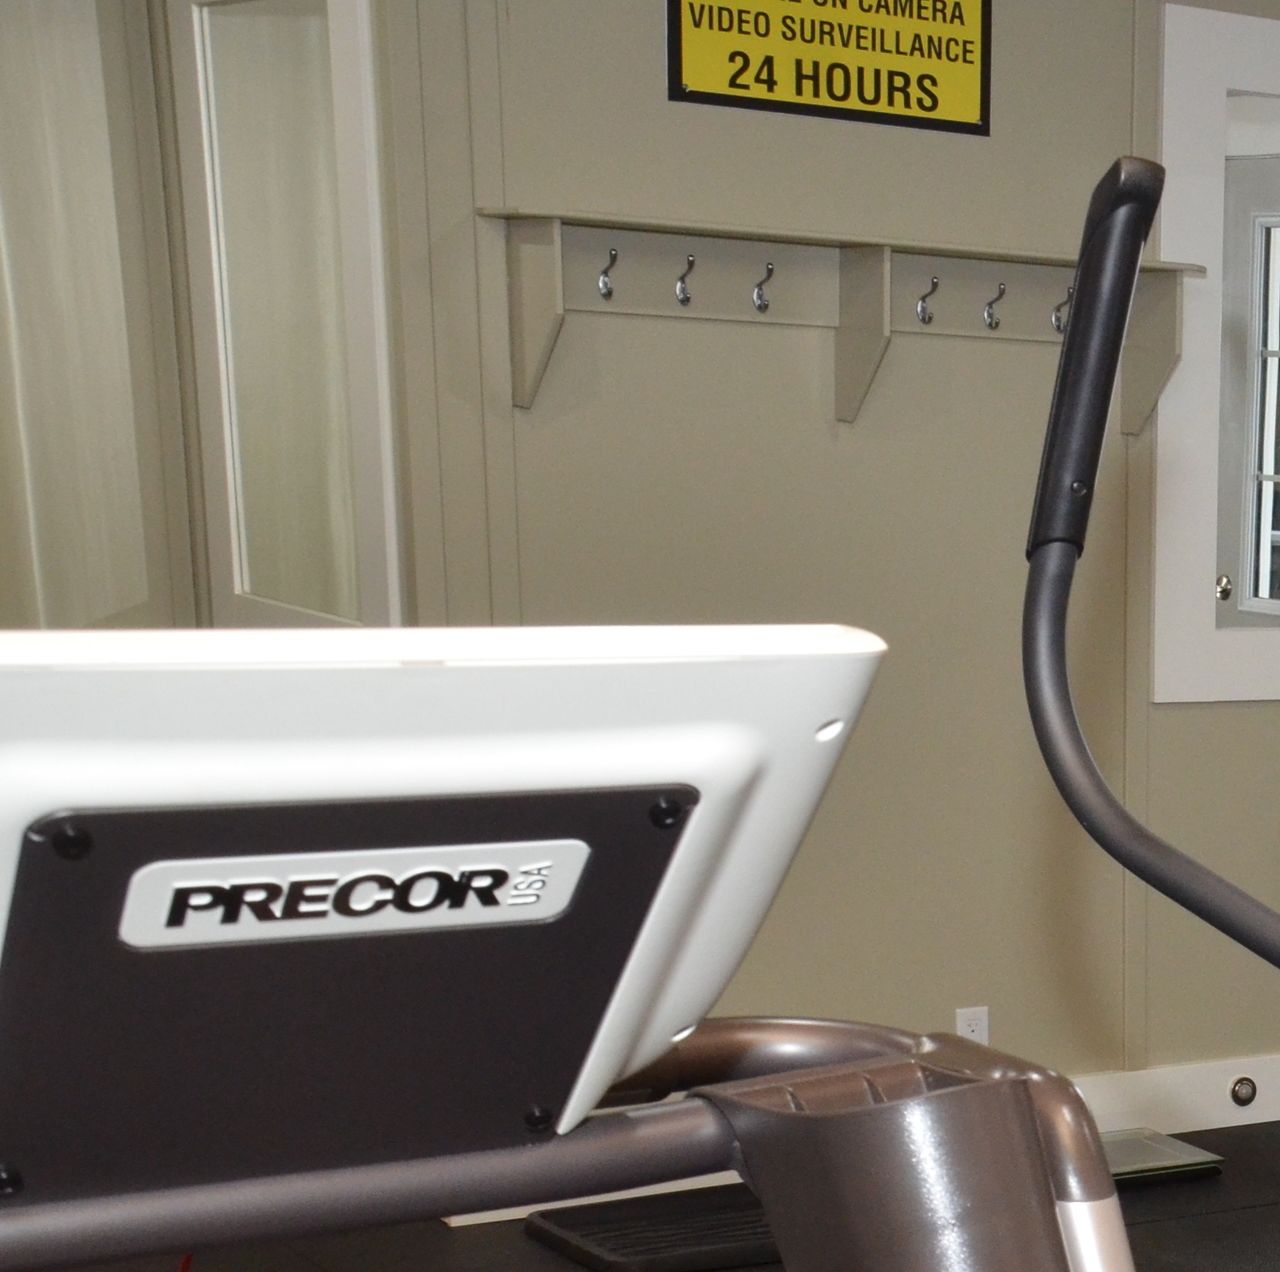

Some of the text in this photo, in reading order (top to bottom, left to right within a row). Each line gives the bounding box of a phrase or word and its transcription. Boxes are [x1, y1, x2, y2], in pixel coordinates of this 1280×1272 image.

[688, 2, 976, 65] VIDEO SURVEILLANCE
[728, 50, 940, 113] 24 HOURS
[165, 861, 554, 928] PRECOR USA
